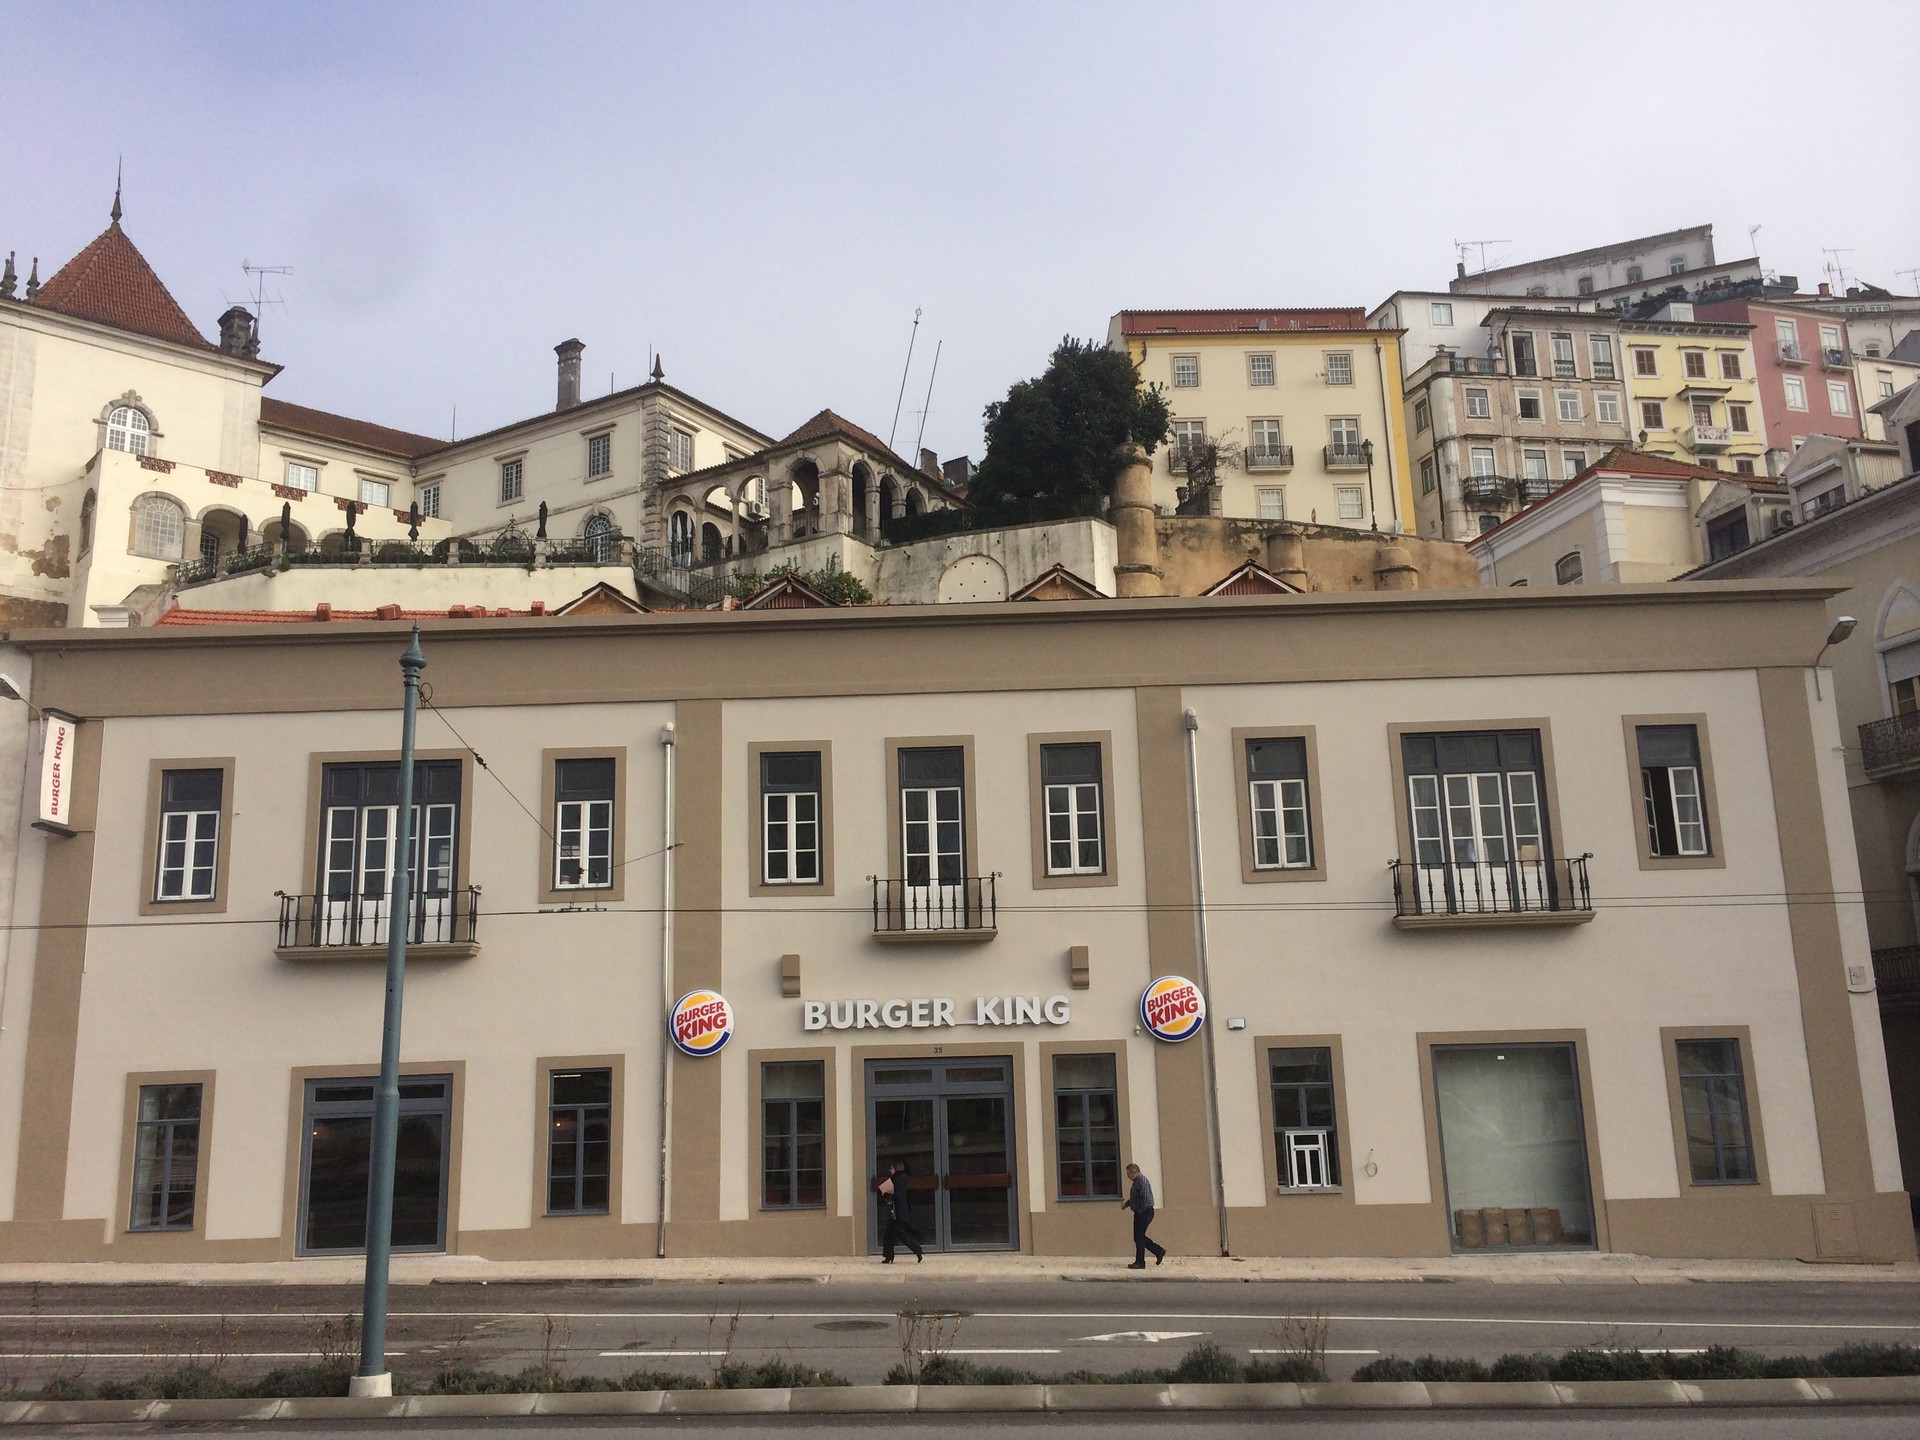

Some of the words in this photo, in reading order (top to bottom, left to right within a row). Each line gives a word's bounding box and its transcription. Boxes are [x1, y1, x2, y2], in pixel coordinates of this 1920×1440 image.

[54, 726, 66, 759] KING
[50, 762, 61, 815] BURGER
[676, 1001, 725, 1027] BURGER
[804, 998, 956, 1030] BURGER
[976, 995, 1071, 1025] KING
[1147, 986, 1194, 1012] BURGER
[1151, 997, 1198, 1029] KING
[679, 1012, 727, 1043] KING
